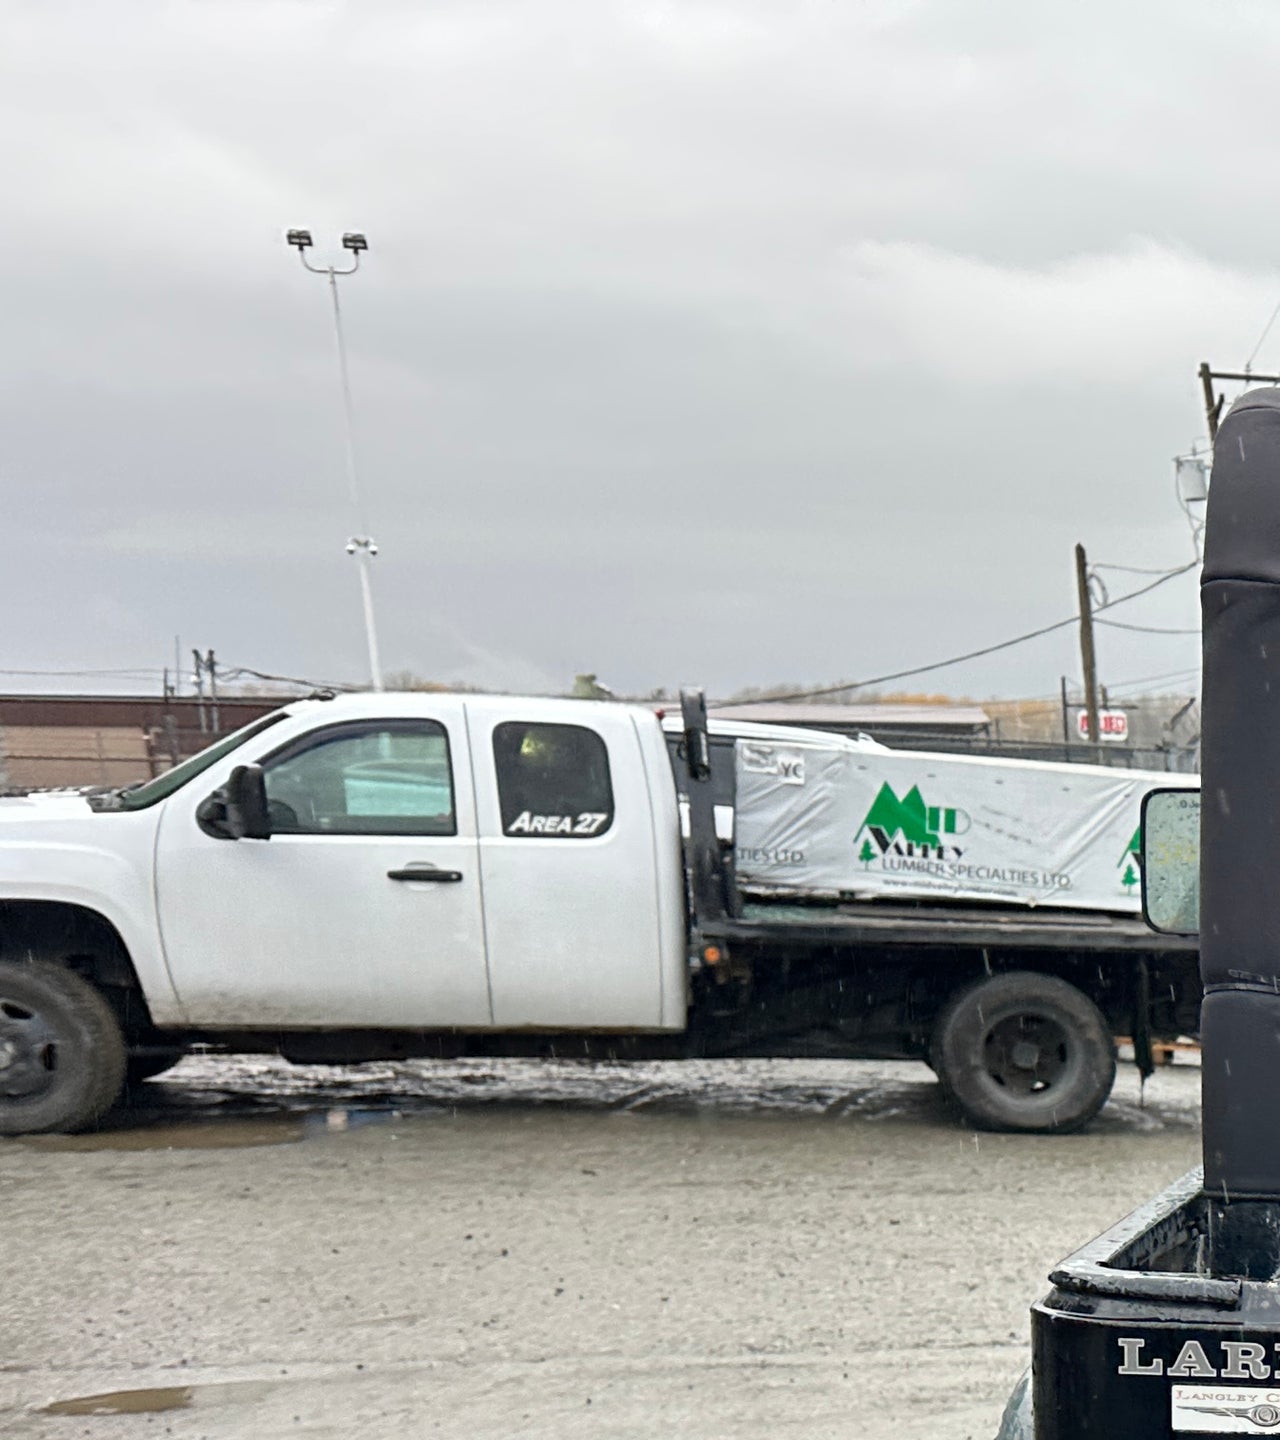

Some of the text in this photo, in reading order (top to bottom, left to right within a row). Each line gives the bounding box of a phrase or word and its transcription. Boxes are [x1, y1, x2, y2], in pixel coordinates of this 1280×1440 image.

[508, 811, 608, 833] AREA 27
[882, 857, 945, 875] LUMBER
[949, 862, 1038, 885] SPECIALTIES
[1175, 1390, 1258, 1403] LANGLEY
